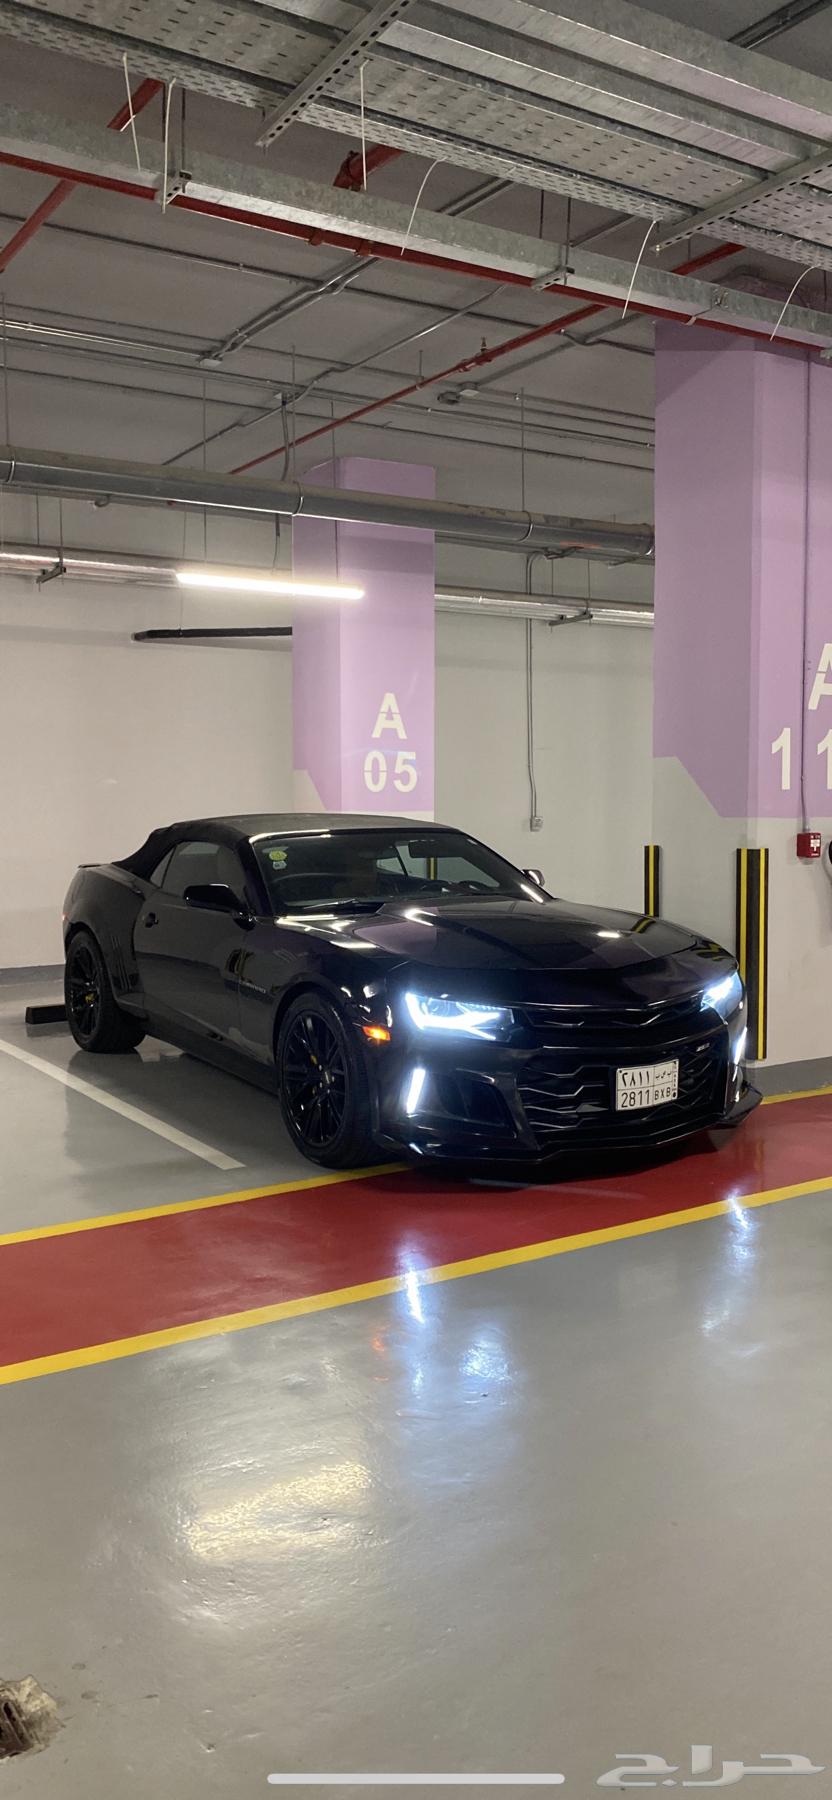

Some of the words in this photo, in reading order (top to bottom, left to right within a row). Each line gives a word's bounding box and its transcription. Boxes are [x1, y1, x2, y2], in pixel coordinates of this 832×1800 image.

[371, 693, 407, 739] A
[364, 750, 417, 793] 05
[621, 1089, 650, 1108] 2811
